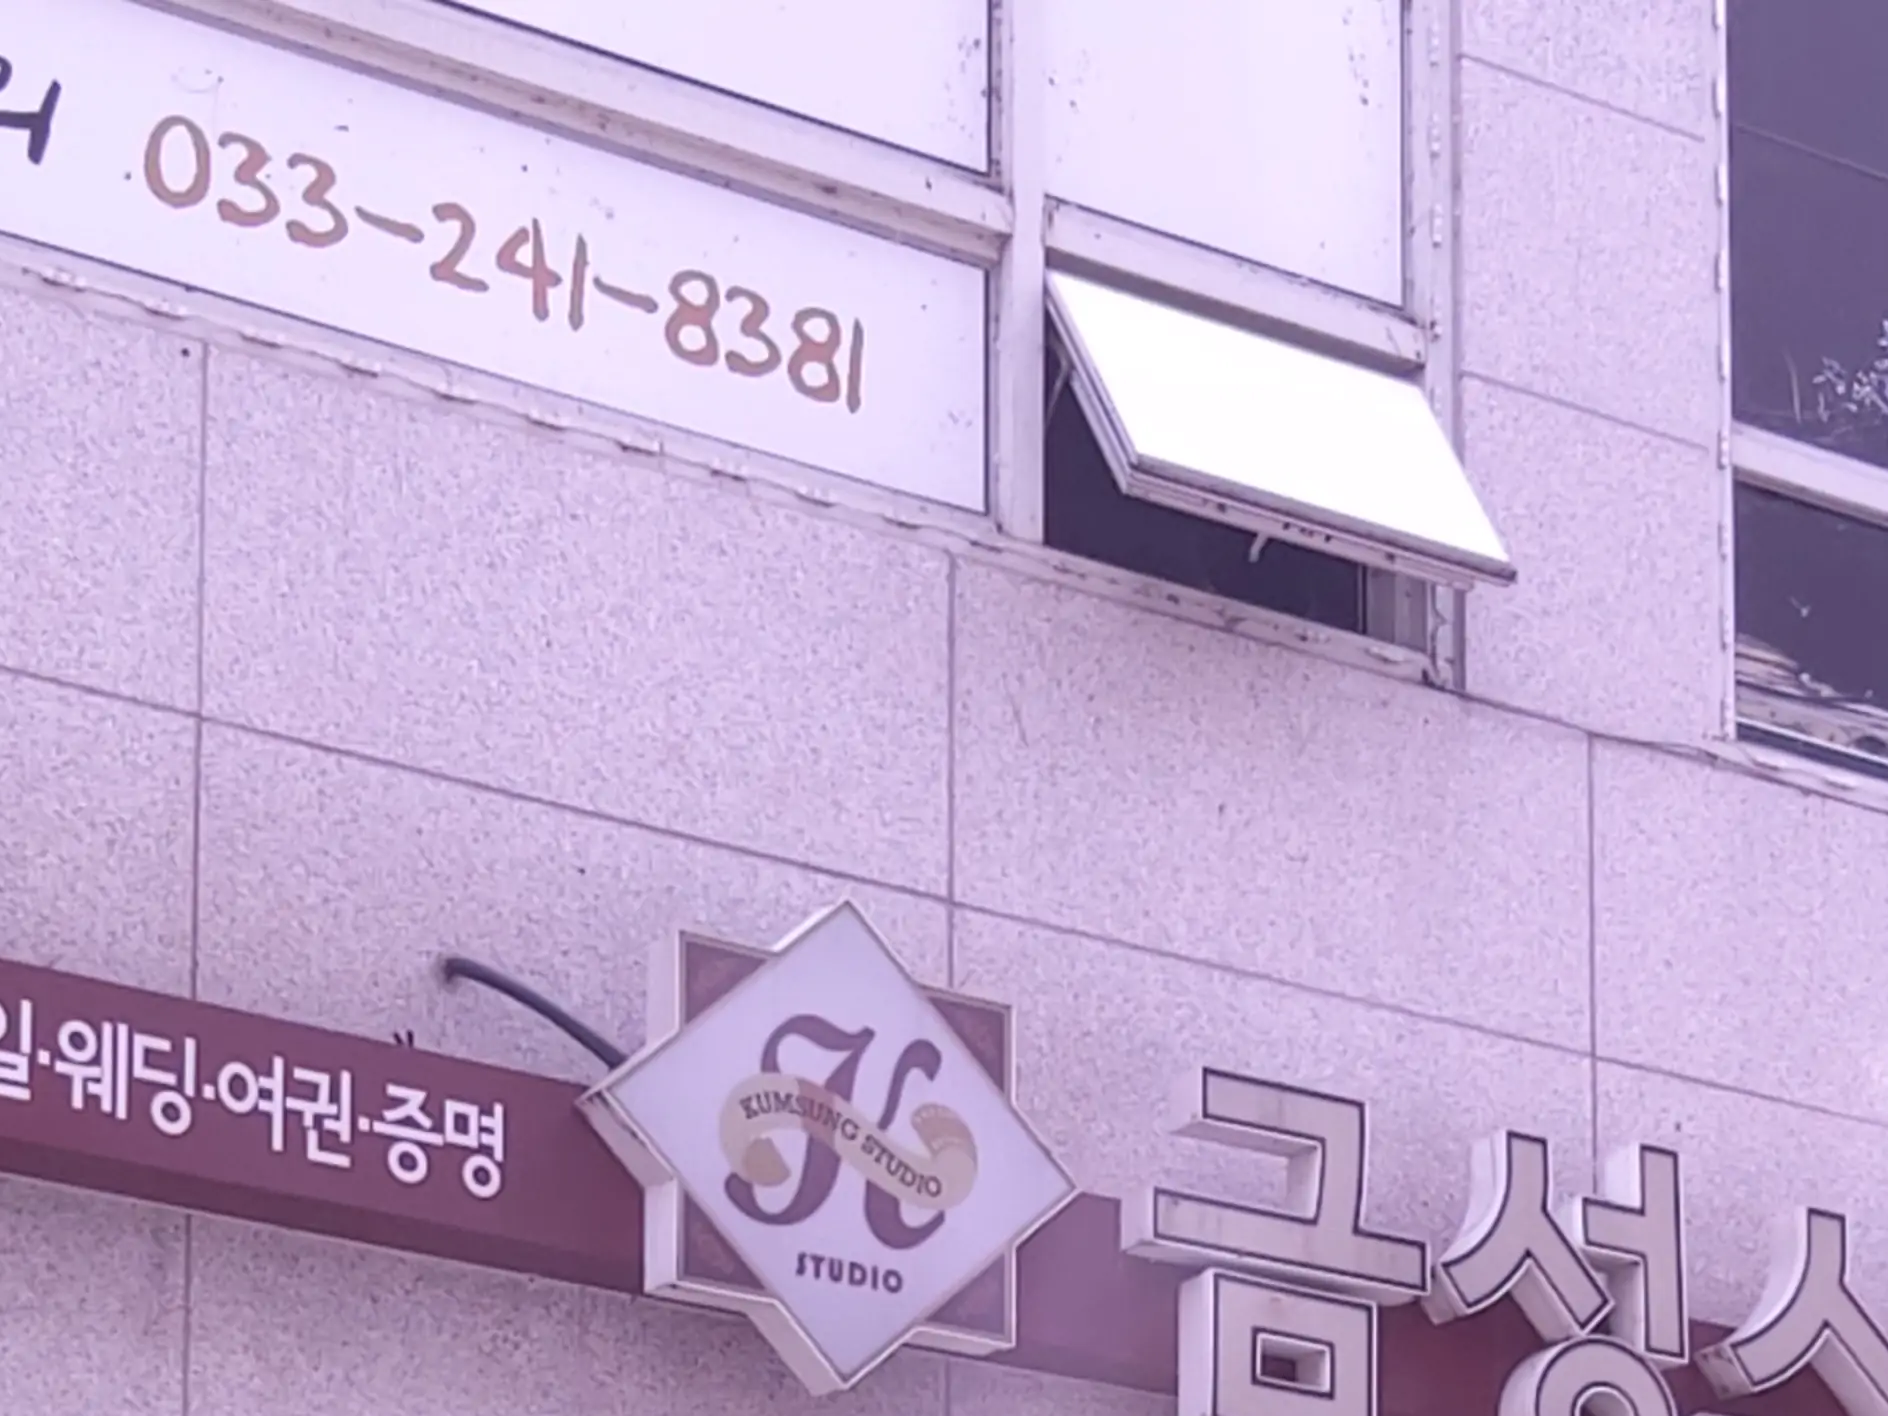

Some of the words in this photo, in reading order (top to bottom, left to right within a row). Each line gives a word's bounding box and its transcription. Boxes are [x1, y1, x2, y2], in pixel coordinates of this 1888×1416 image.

[144, 113, 865, 413] 033-241-8381
[738, 1090, 860, 1142] KUMSUNG
[861, 1132, 943, 1198] STUDIO
[794, 1251, 904, 1294] STUDIO
